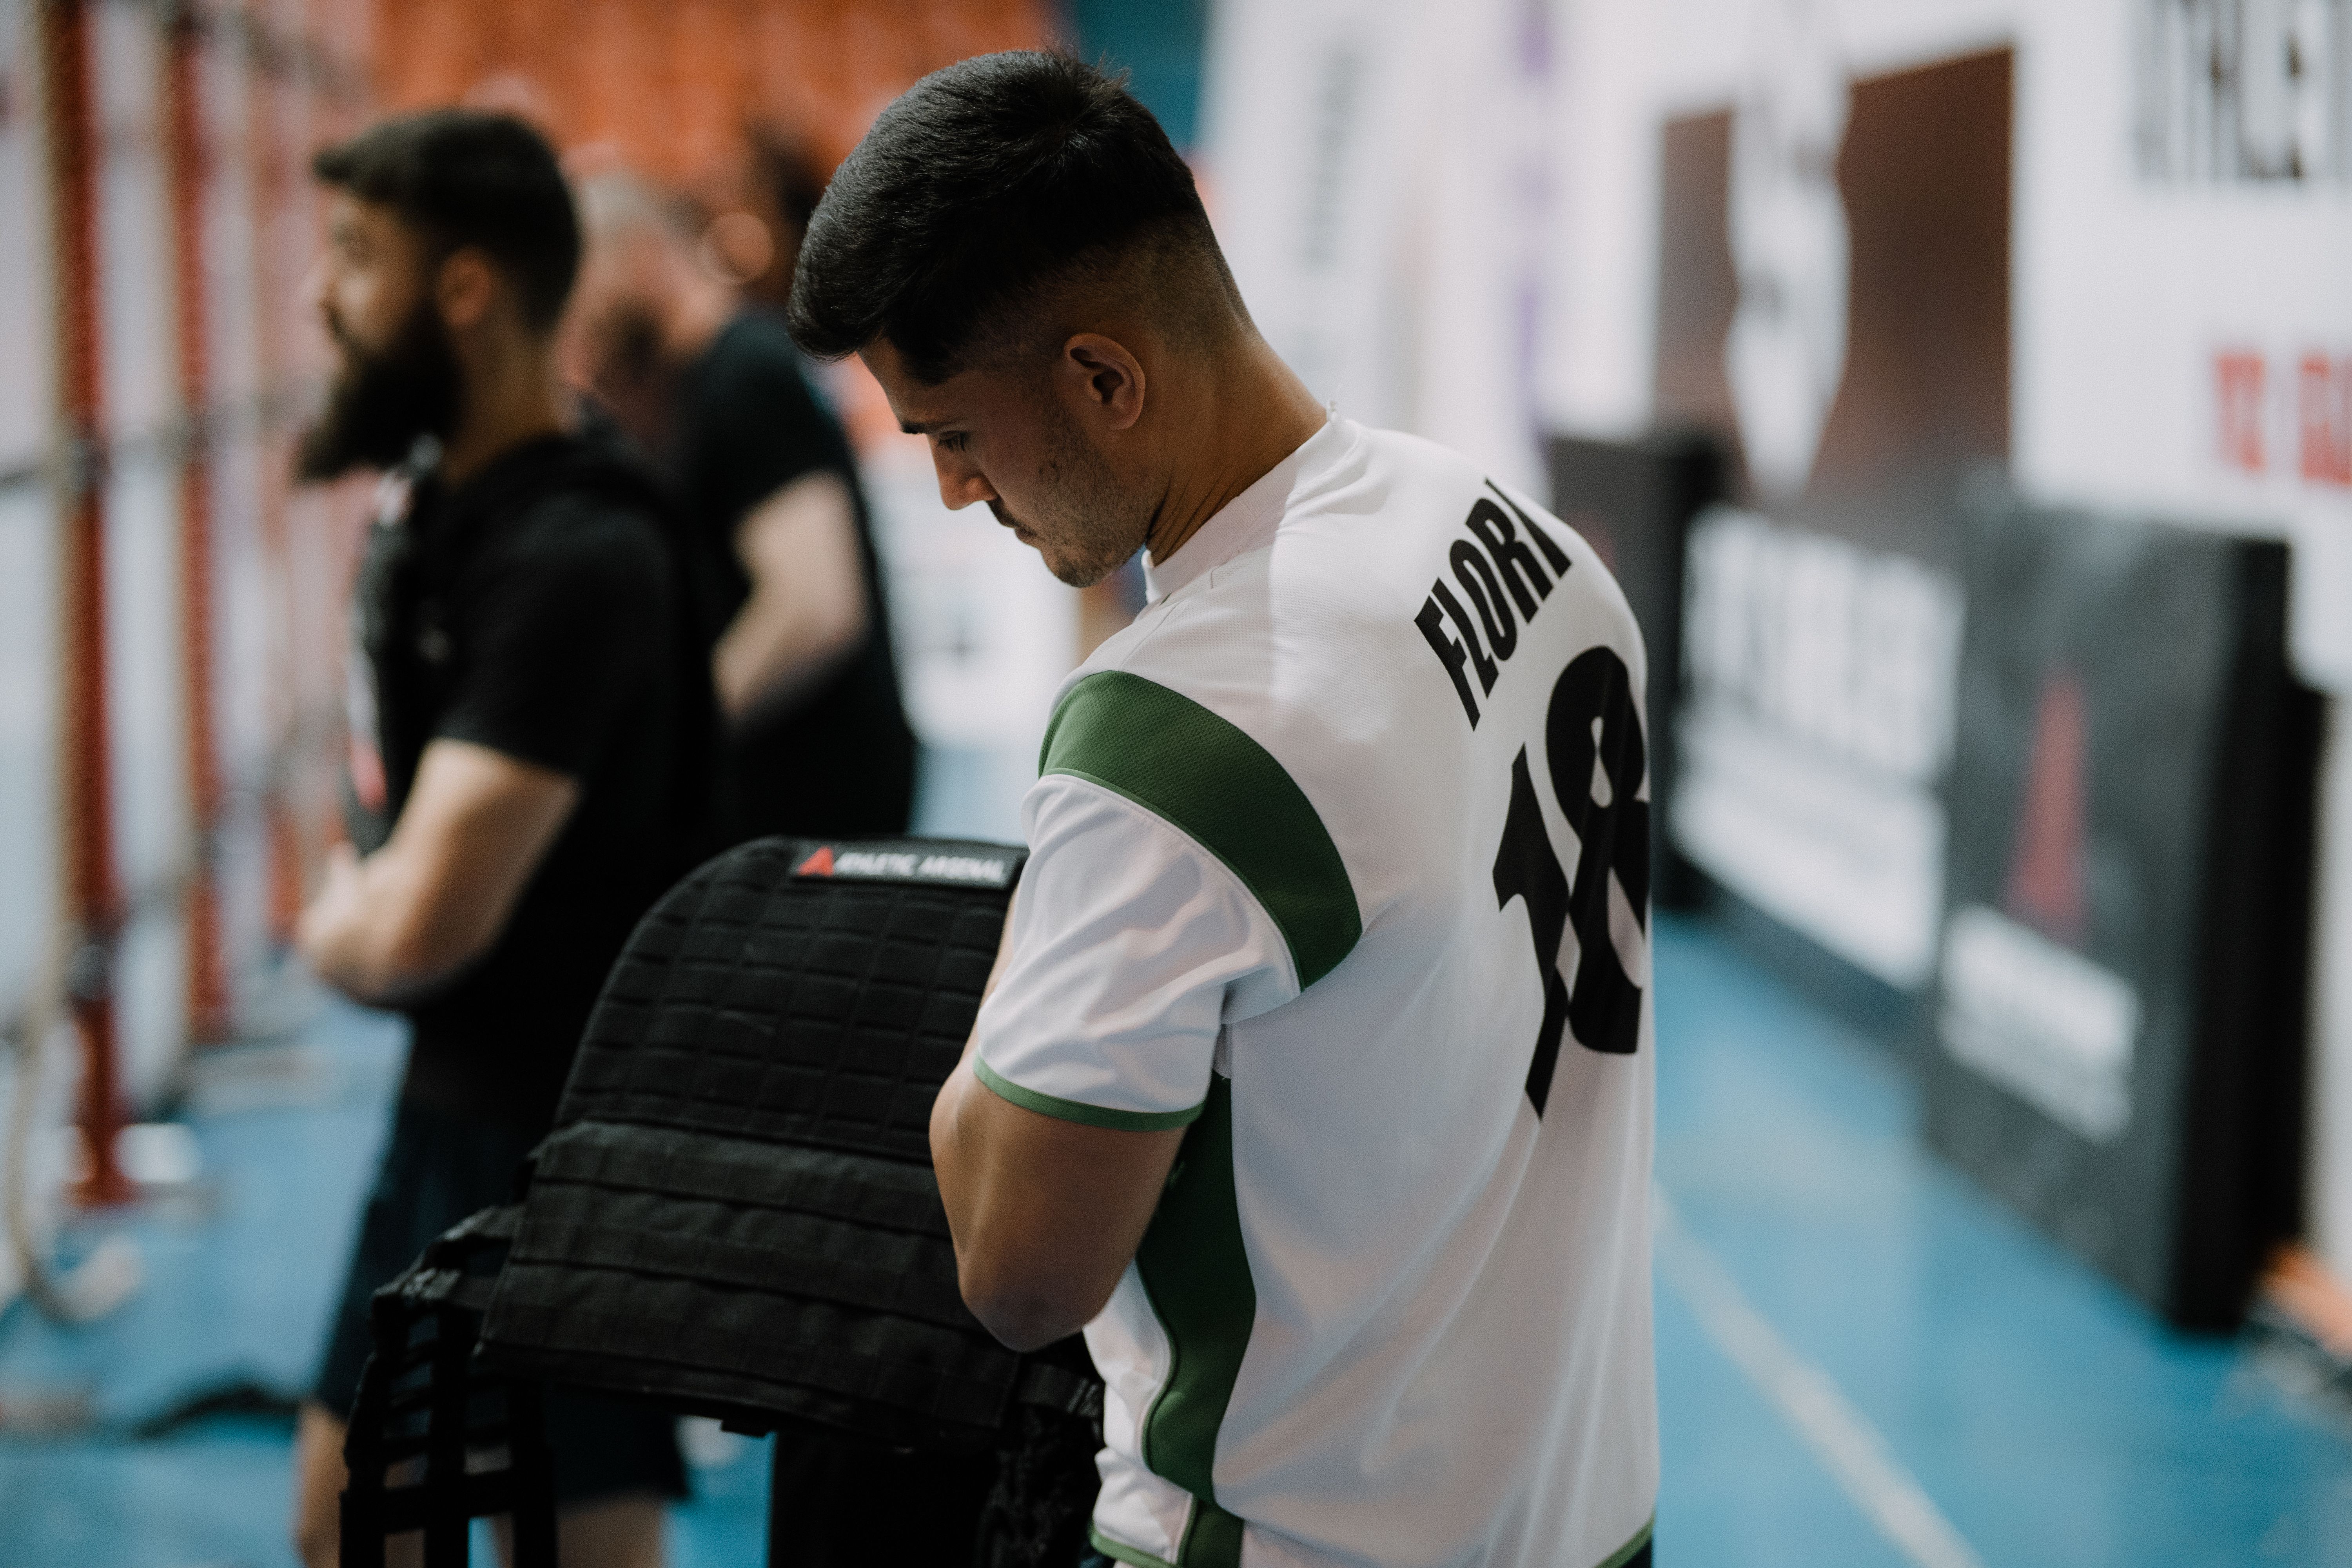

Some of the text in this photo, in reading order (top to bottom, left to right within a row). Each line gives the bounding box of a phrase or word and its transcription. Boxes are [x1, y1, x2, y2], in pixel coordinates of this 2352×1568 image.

[835, 851, 1006, 883] ATHLETIC ARSENAL
[1492, 646, 1650, 1120] 18
